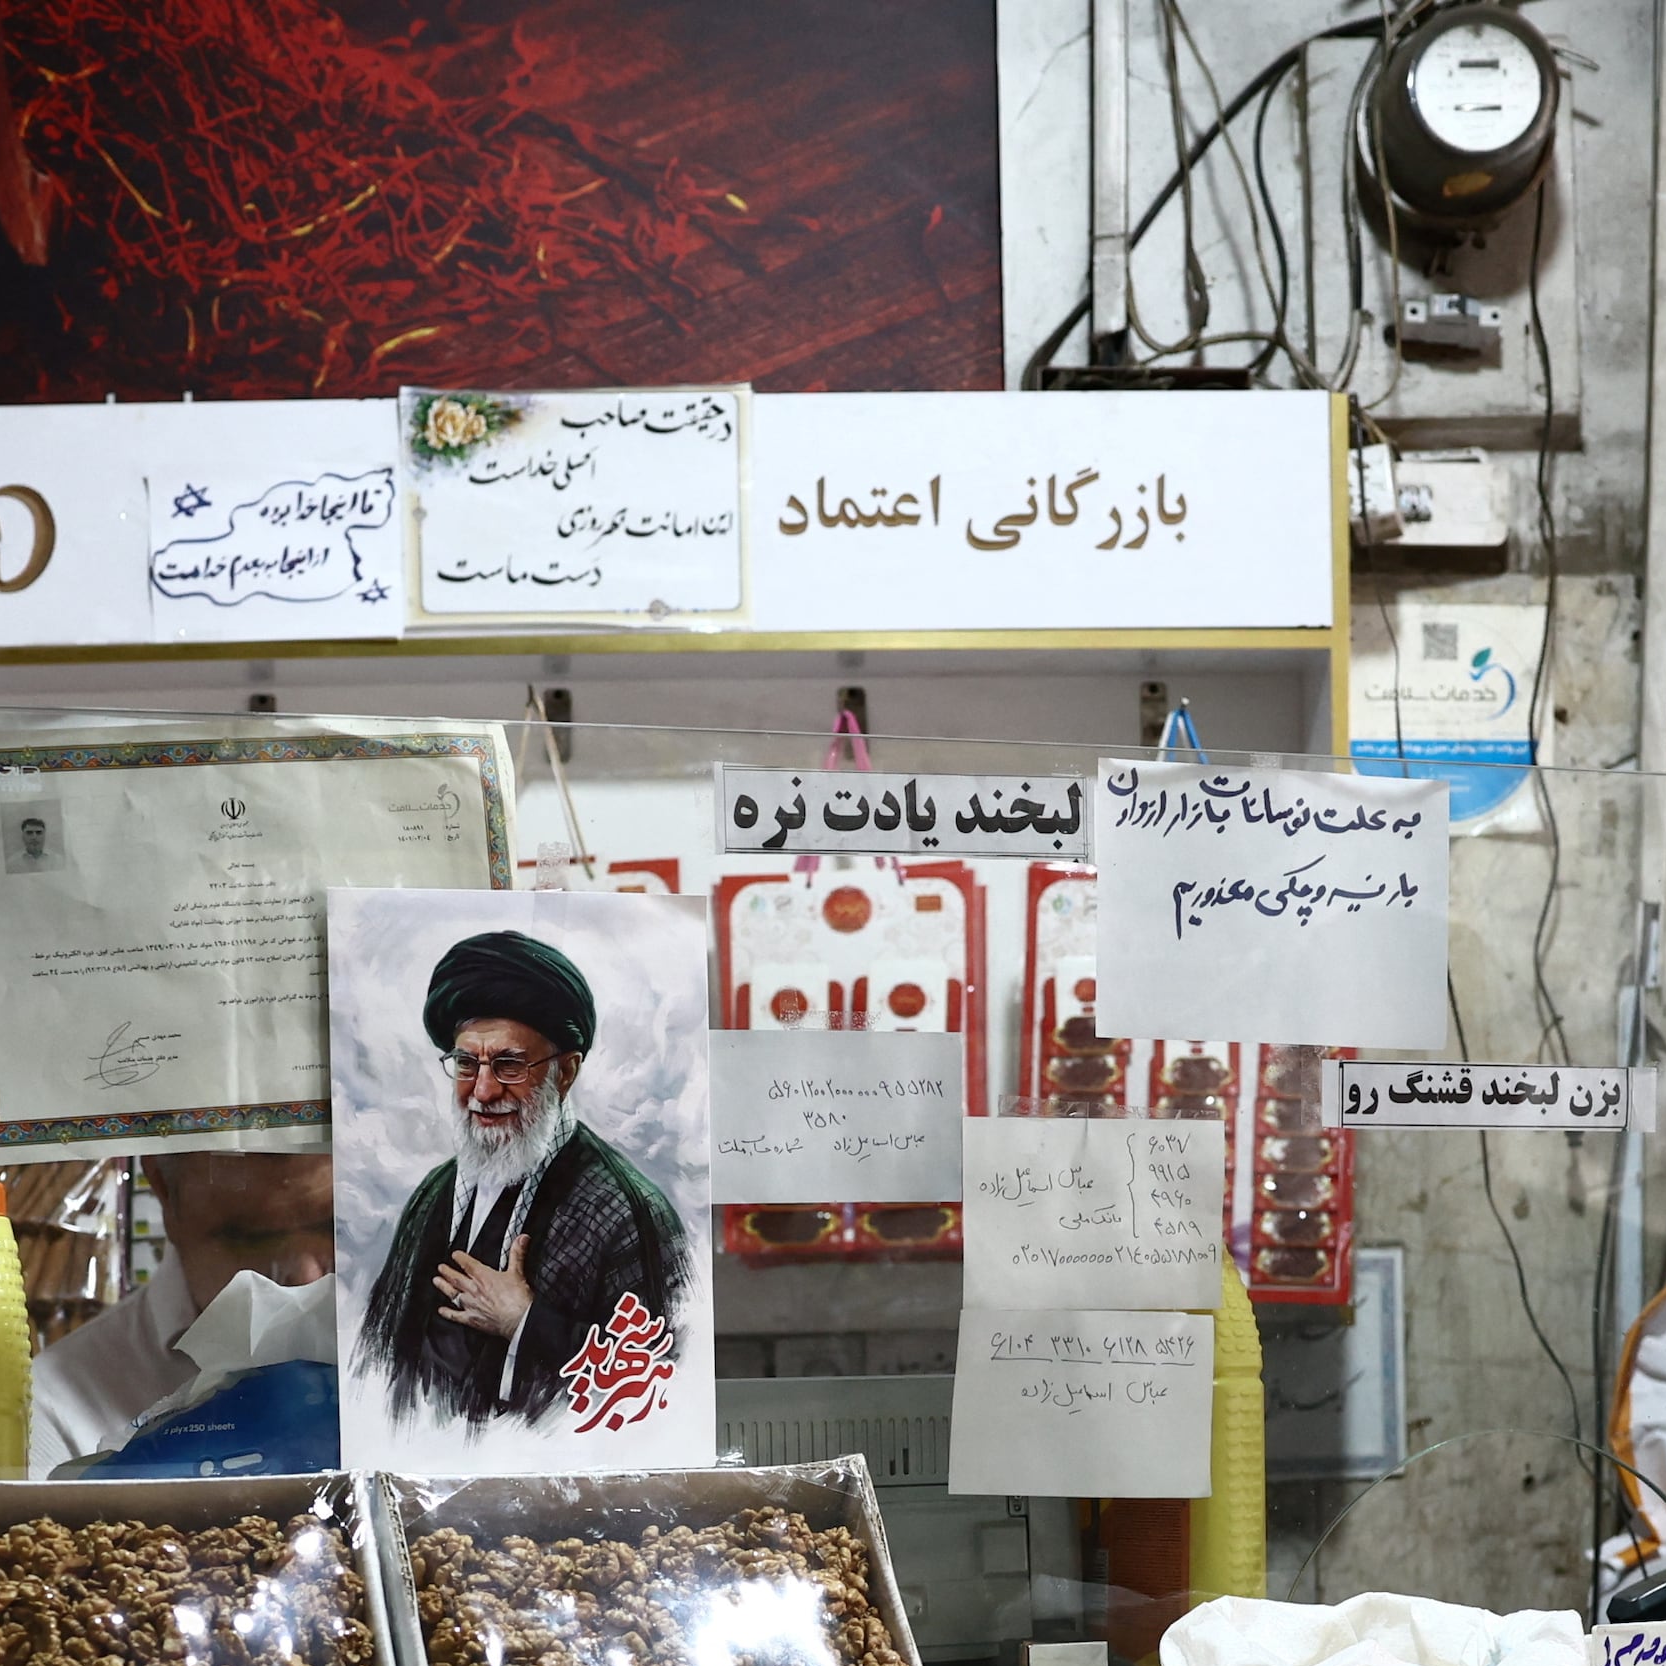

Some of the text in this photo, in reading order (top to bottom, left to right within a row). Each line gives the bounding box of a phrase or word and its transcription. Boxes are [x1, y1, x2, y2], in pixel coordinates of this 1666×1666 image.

[561, 400, 646, 440] صاحب
[645, 398, 725, 434] حقیقت
[468, 450, 554, 485] خداست
[778, 467, 1188, 551] بازرگانی اعتماد
[626, 512, 699, 537] امانت
[437, 554, 602, 586] دست ماست
[733, 776, 1083, 850] لبخند یادت نره
[1164, 792, 1231, 838] بازار
[1315, 808, 1387, 834] علت
[1392, 811, 1422, 840] به
[1254, 854, 1327, 928] چکی
[1172, 878, 1255, 941] معذوریم
[1345, 1068, 1622, 1118] بزن لبخند قشنگ رو
[775, 1138, 803, 1154] شماره
[895, 1134, 925, 1150] عباس
[1147, 1132, 1191, 1156] ۶۰۳۷
[1147, 1162, 1190, 1182] ۹۹۱۵
[990, 1332, 1034, 1357] ۶۱۰۴
[1050, 1334, 1092, 1358] ۳۳۱۰
[1103, 1336, 1149, 1359] ۶۱۲۸
[1126, 1380, 1169, 1406] عباس
[208, 1423, 235, 1432] sheets
